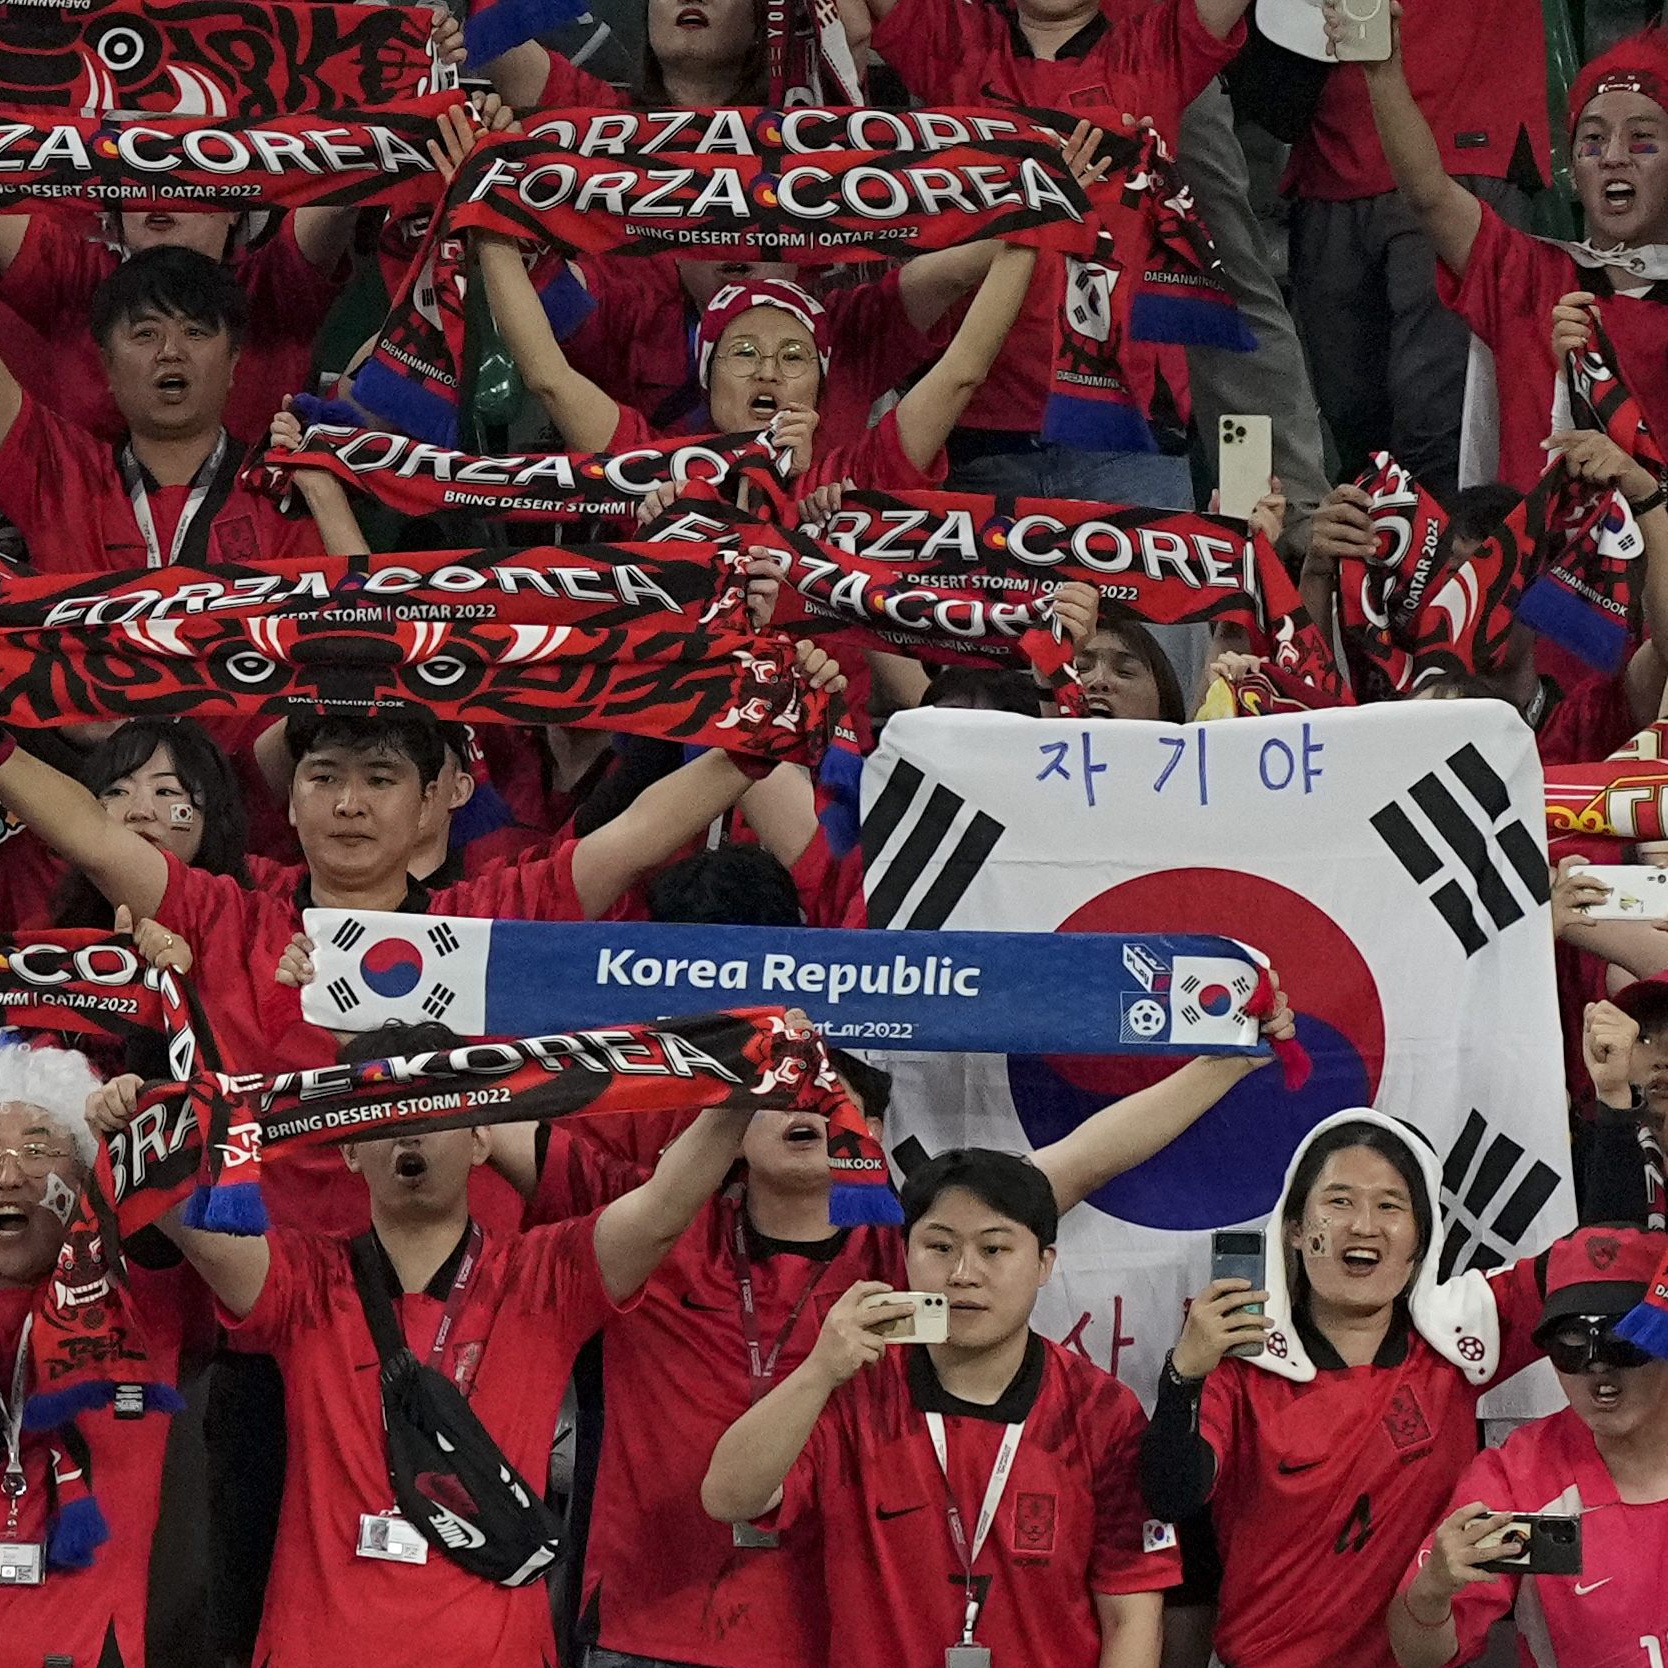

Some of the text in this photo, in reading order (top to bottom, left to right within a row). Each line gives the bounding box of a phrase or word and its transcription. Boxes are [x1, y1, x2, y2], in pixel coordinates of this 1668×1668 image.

[118, 124, 436, 175] COREA
[20, 183, 84, 198] DESERT
[86, 184, 148, 200] STORM
[160, 184, 216, 200] QATAR
[218, 183, 262, 198] 2022
[467, 156, 1085, 223] FORZA COREA
[625, 222, 920, 248] BRING DESERT STORM QATAR 2022
[443, 489, 626, 515] BRING DESERT STORM
[907, 573, 1139, 600] DESERT STORM 2022
[1403, 517, 1440, 611] QATAR 2022
[42, 563, 683, 629] FORZA COREA
[322, 603, 497, 622] STORM QATAR 2022
[1036, 723, 1325, 806] 자기야
[595, 949, 981, 1004] Korea Republic
[41, 994, 98, 1010] QATAR
[99, 997, 140, 1015] 2022
[384, 1028, 744, 1087] KOREA
[266, 1087, 512, 1140] BRING DESERT STORM 2022
[428, 1514, 470, 1549] NIKE
